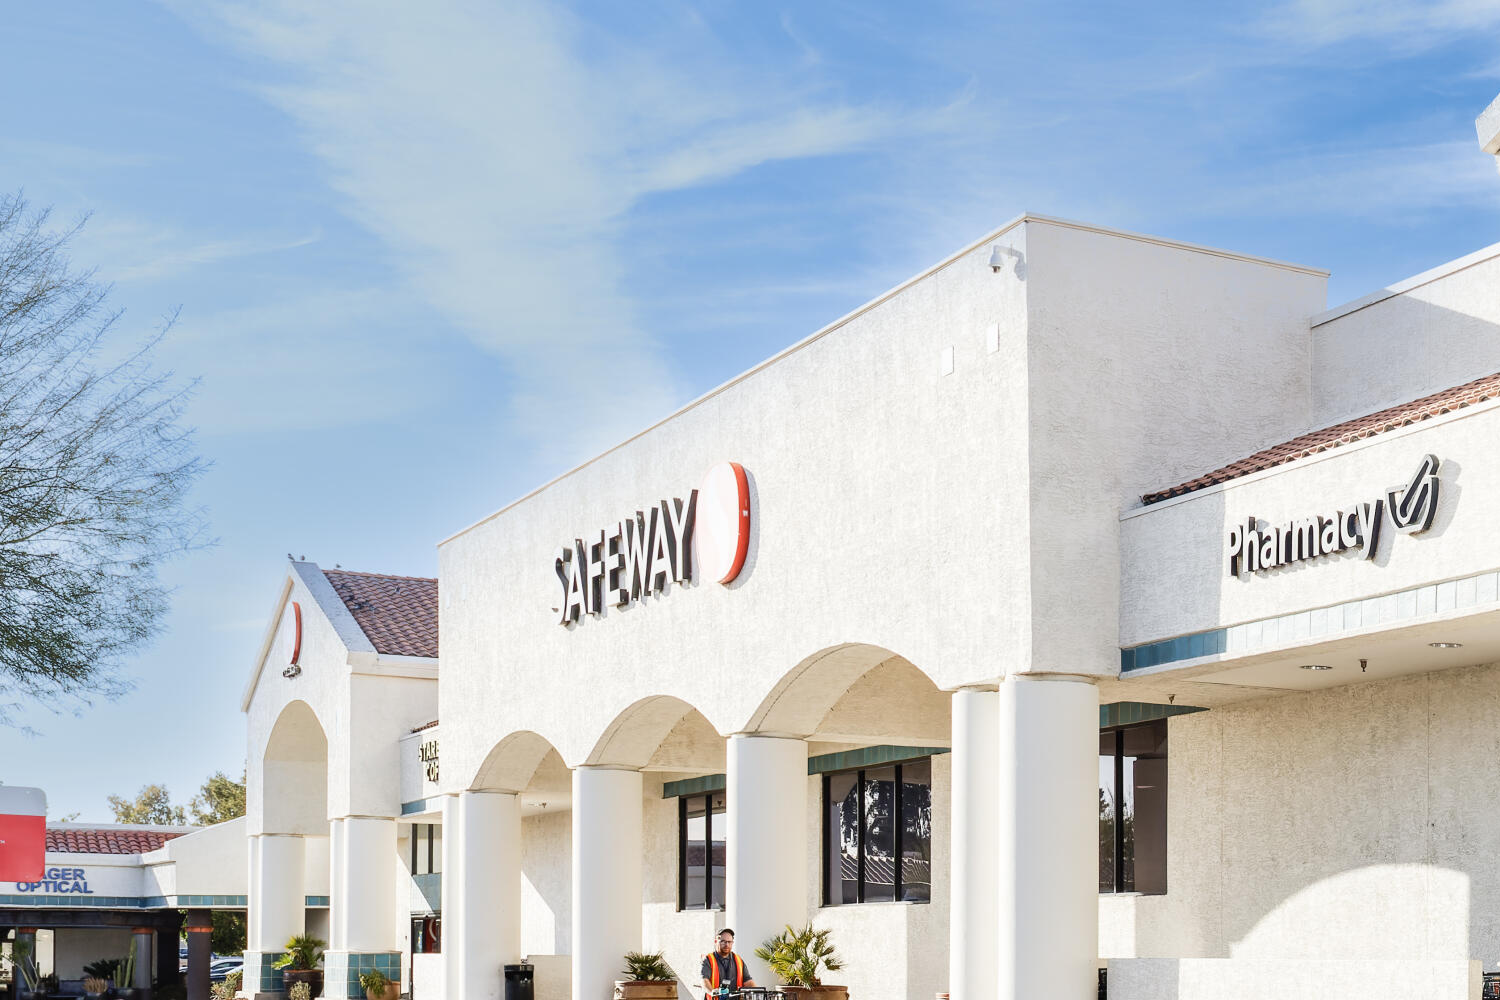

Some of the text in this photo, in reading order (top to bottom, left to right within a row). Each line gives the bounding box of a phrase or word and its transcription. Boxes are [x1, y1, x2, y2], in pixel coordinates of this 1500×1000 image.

[551, 489, 699, 626] SAFEWAY
[1226, 499, 1384, 578] Pharmacy
[16, 880, 94, 894] OPTICAL
